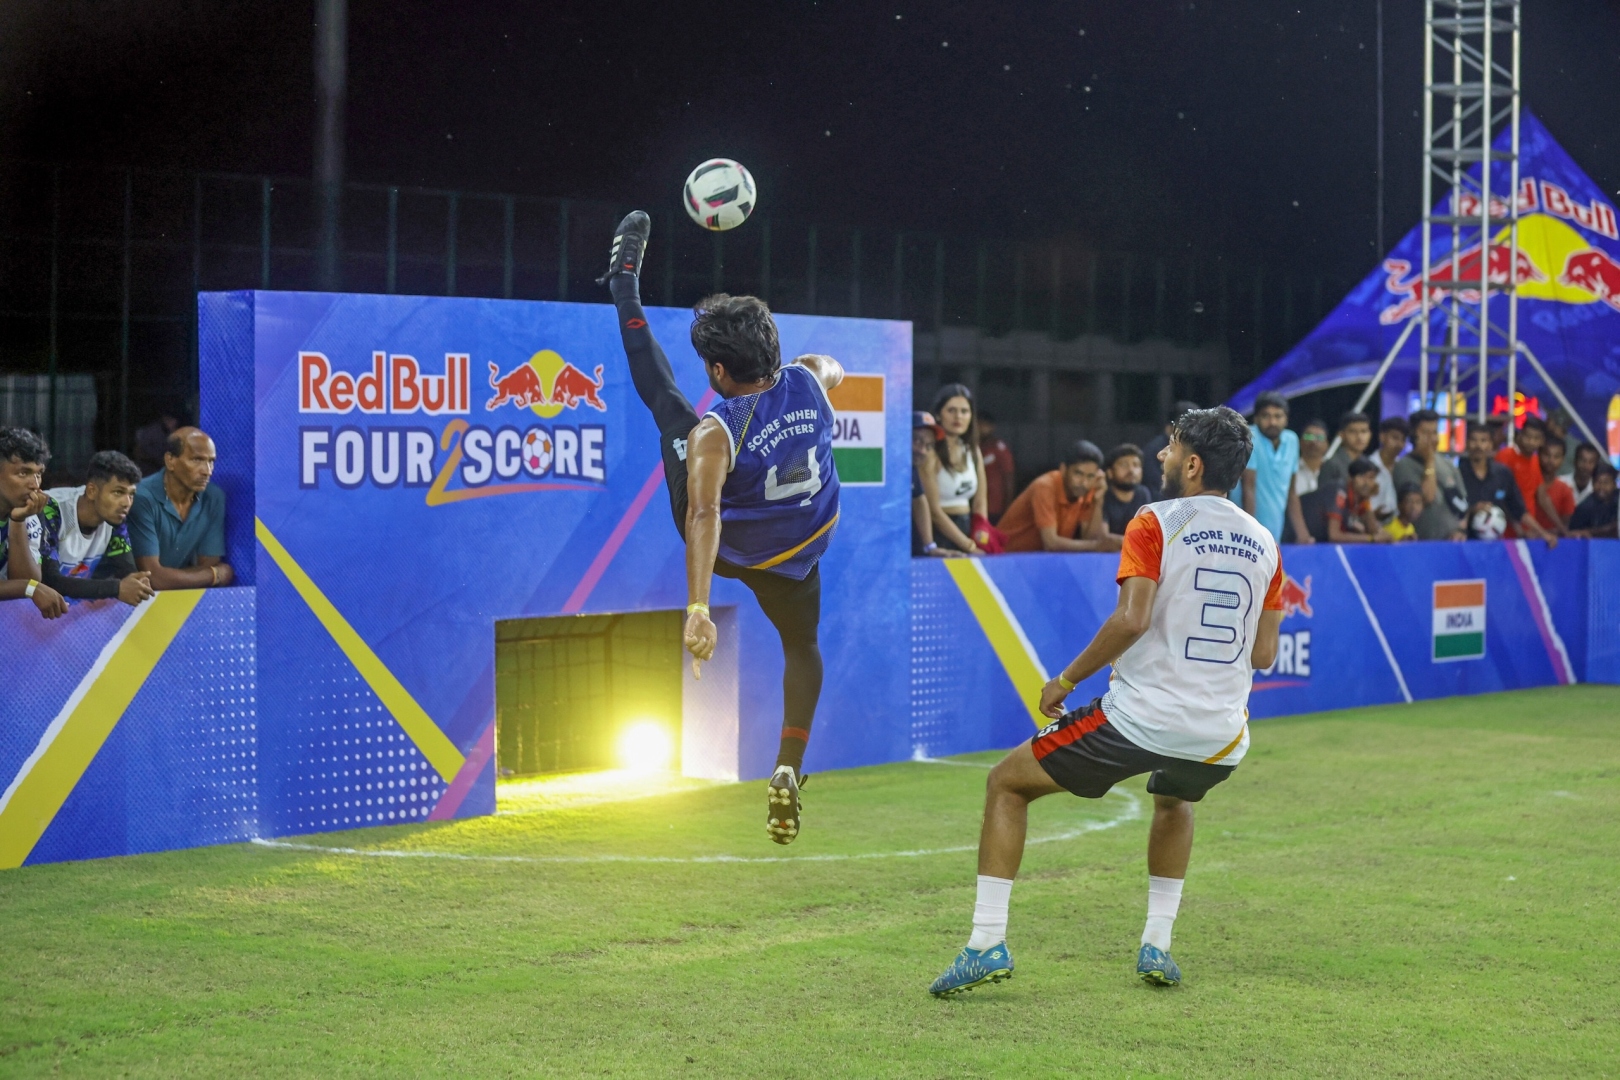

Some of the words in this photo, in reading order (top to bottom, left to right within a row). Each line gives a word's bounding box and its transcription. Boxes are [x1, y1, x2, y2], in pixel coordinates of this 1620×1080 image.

[1541, 180, 1619, 240] Bull
[300, 352, 386, 412] Red
[391, 353, 469, 414] Bull
[747, 419, 781, 452] SCORE
[783, 409, 818, 424] WHEN
[760, 444, 771, 457] IT
[771, 423, 815, 449] MATTERS
[302, 430, 435, 485] FOUR
[765, 445, 823, 507] 4
[1183, 530, 1223, 545] SCORE
[1230, 532, 1265, 556] WHEN
[1195, 545, 1207, 555] IT
[1208, 544, 1258, 563] MATTERS
[1185, 567, 1253, 664] 3
[1446, 612, 1473, 629] INDIA
